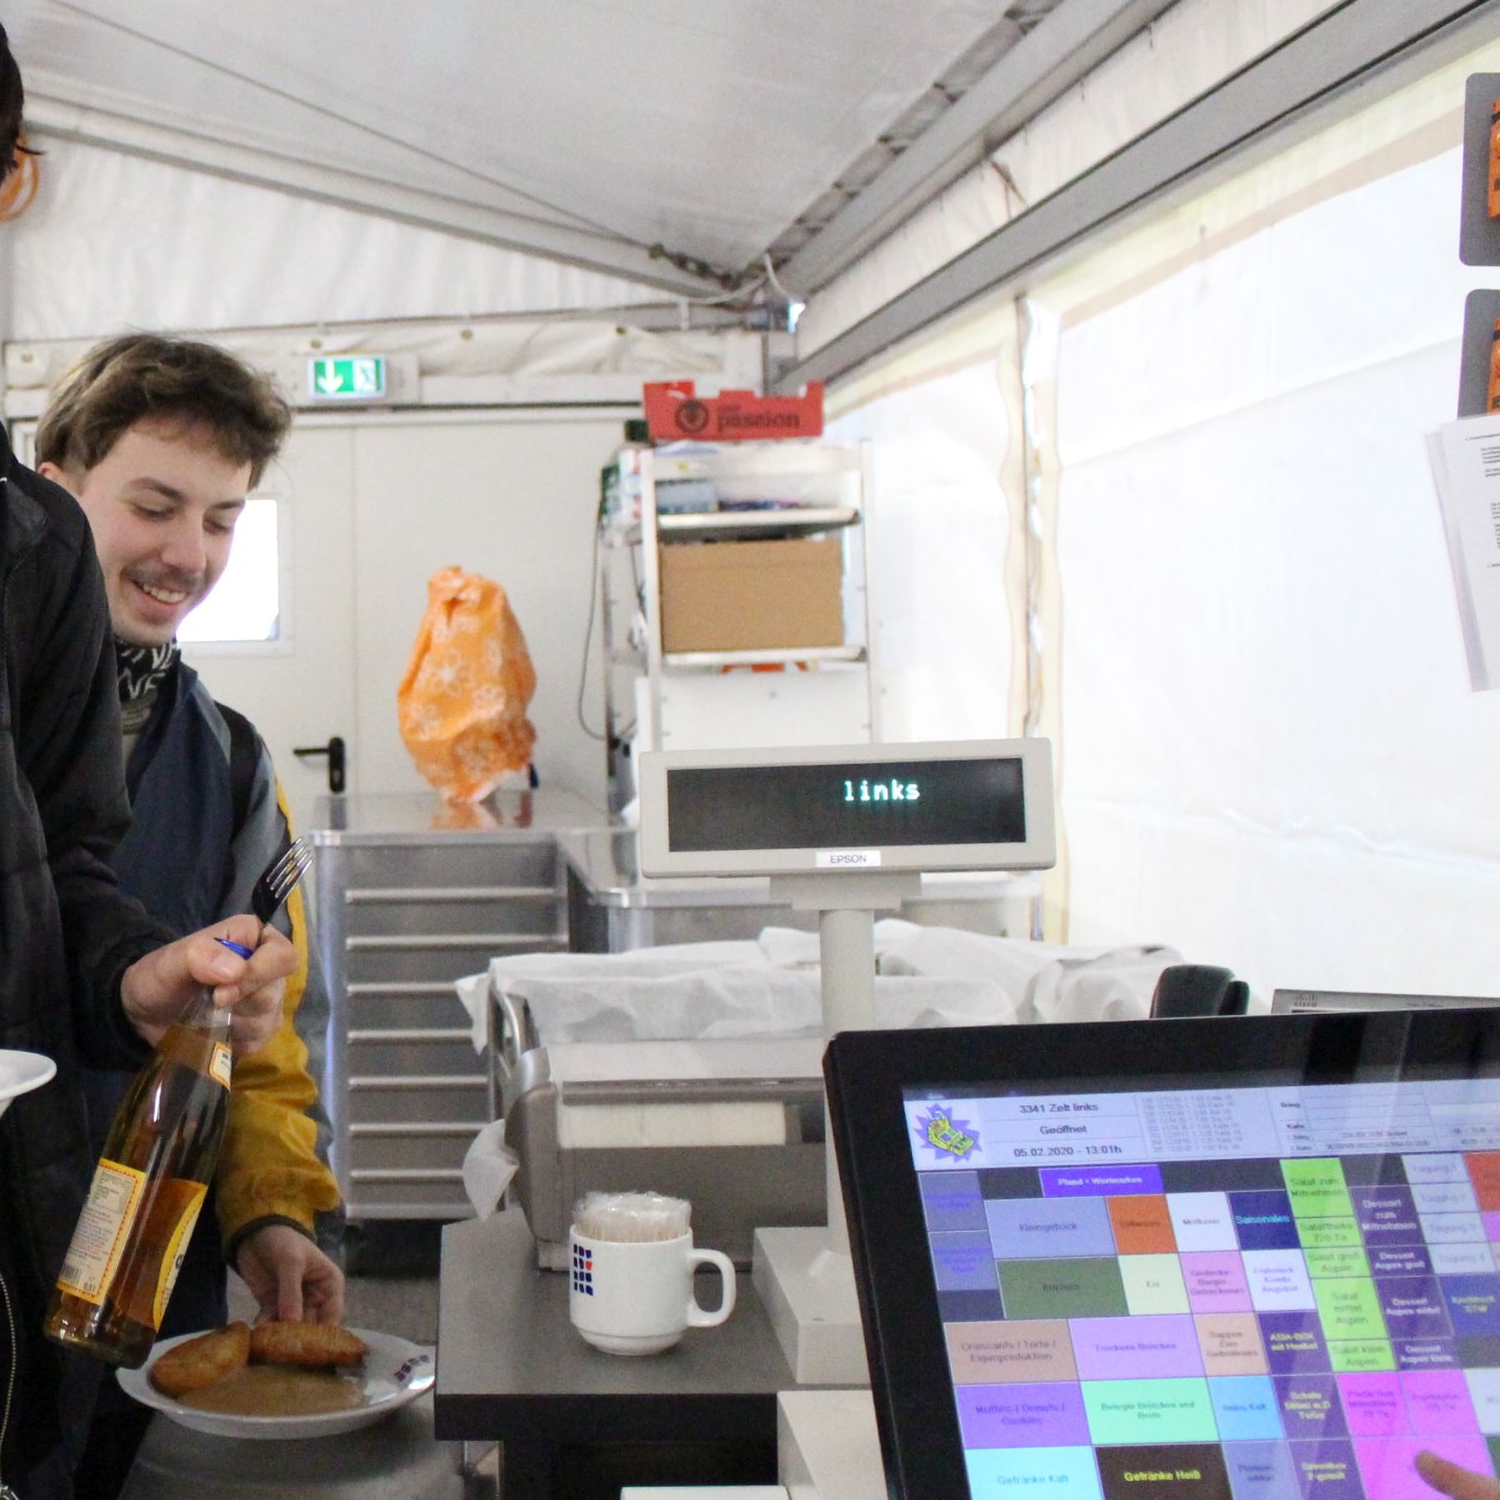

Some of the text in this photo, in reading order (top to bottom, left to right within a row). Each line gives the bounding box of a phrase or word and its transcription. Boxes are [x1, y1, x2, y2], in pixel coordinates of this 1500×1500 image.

[843, 779, 921, 803] links
[829, 853, 868, 865] EPSON
[1019, 1102, 1099, 1114] 3341 Zelt links
[1039, 1125, 1088, 1135] Geöffnet
[1013, 1147, 1075, 1158] 05.02.2020
[1085, 1145, 1122, 1156] 13:01h
[1123, 1469, 1203, 1483] Getränke Heiß
